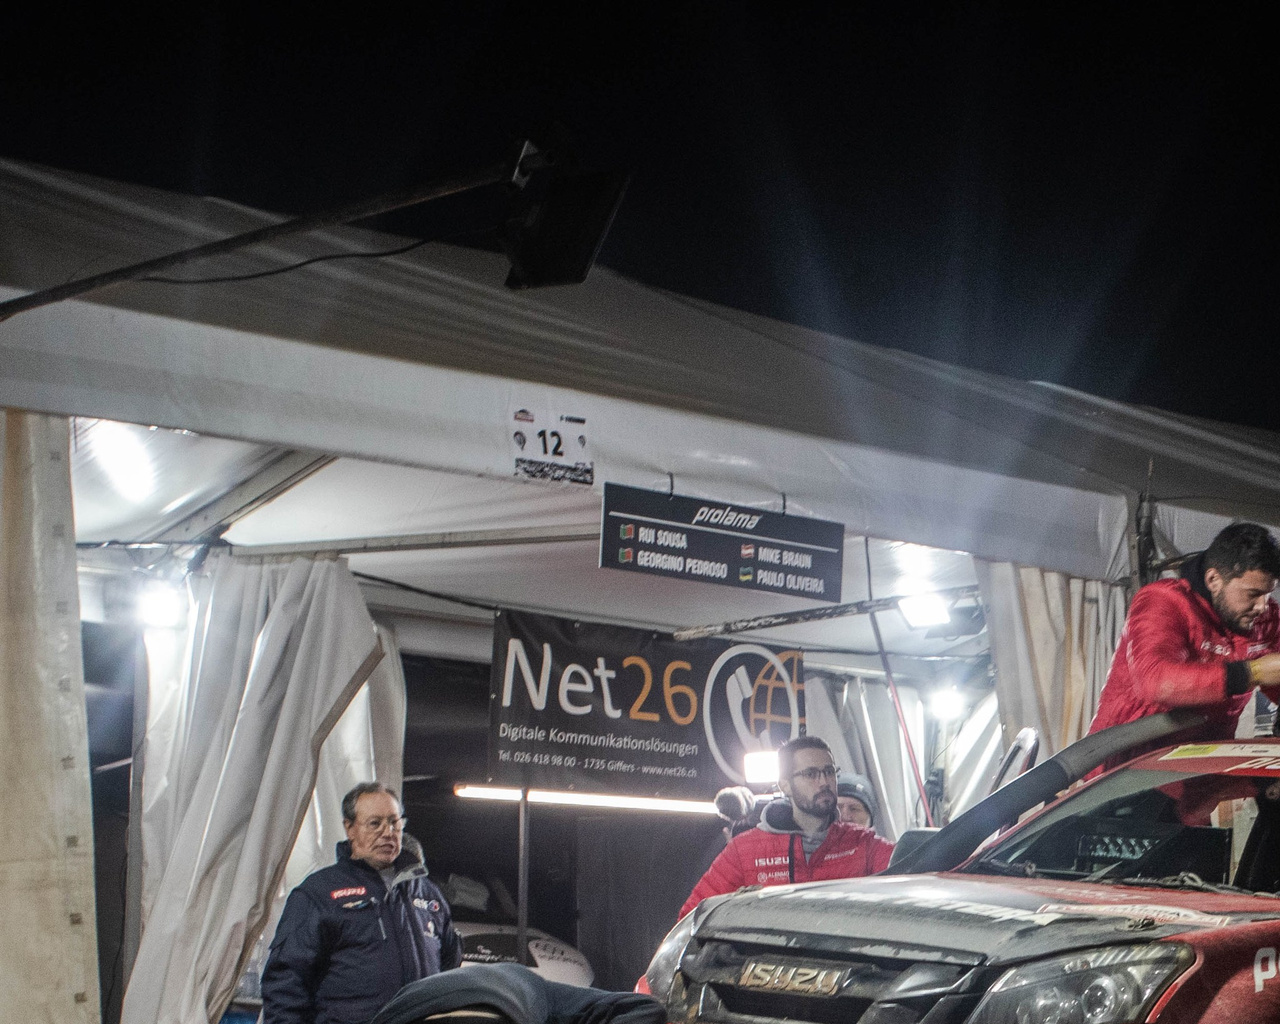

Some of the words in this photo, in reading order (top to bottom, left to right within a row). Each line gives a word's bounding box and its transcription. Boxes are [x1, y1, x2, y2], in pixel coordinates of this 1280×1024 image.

[537, 429, 563, 456] 12
[691, 506, 763, 530] prolama
[638, 526, 656, 544] RUI
[656, 529, 688, 550] SOUSA
[637, 550, 684, 572] GEORGINO
[685, 558, 728, 579] PEDROSO
[757, 546, 781, 565] MIKE
[782, 550, 812, 570] BRAUN
[756, 569, 785, 588] PAULO
[786, 574, 825, 594] OLIVEIRA
[502, 638, 698, 725] Net26
[499, 723, 546, 741] Digitale
[549, 728, 698, 757] Kommunikationslösungen
[498, 750, 512, 762] Tel.
[513, 752, 531, 763] 026
[532, 753, 549, 765] 418
[551, 756, 563, 766] 98
[564, 756, 576, 767] 00
[584, 758, 605, 770] 1735
[607, 760, 635, 773] Giffers
[642, 765, 697, 778] www.net26.ch
[755, 856, 789, 867] ISUZU
[739, 963, 841, 996] ISUZU
